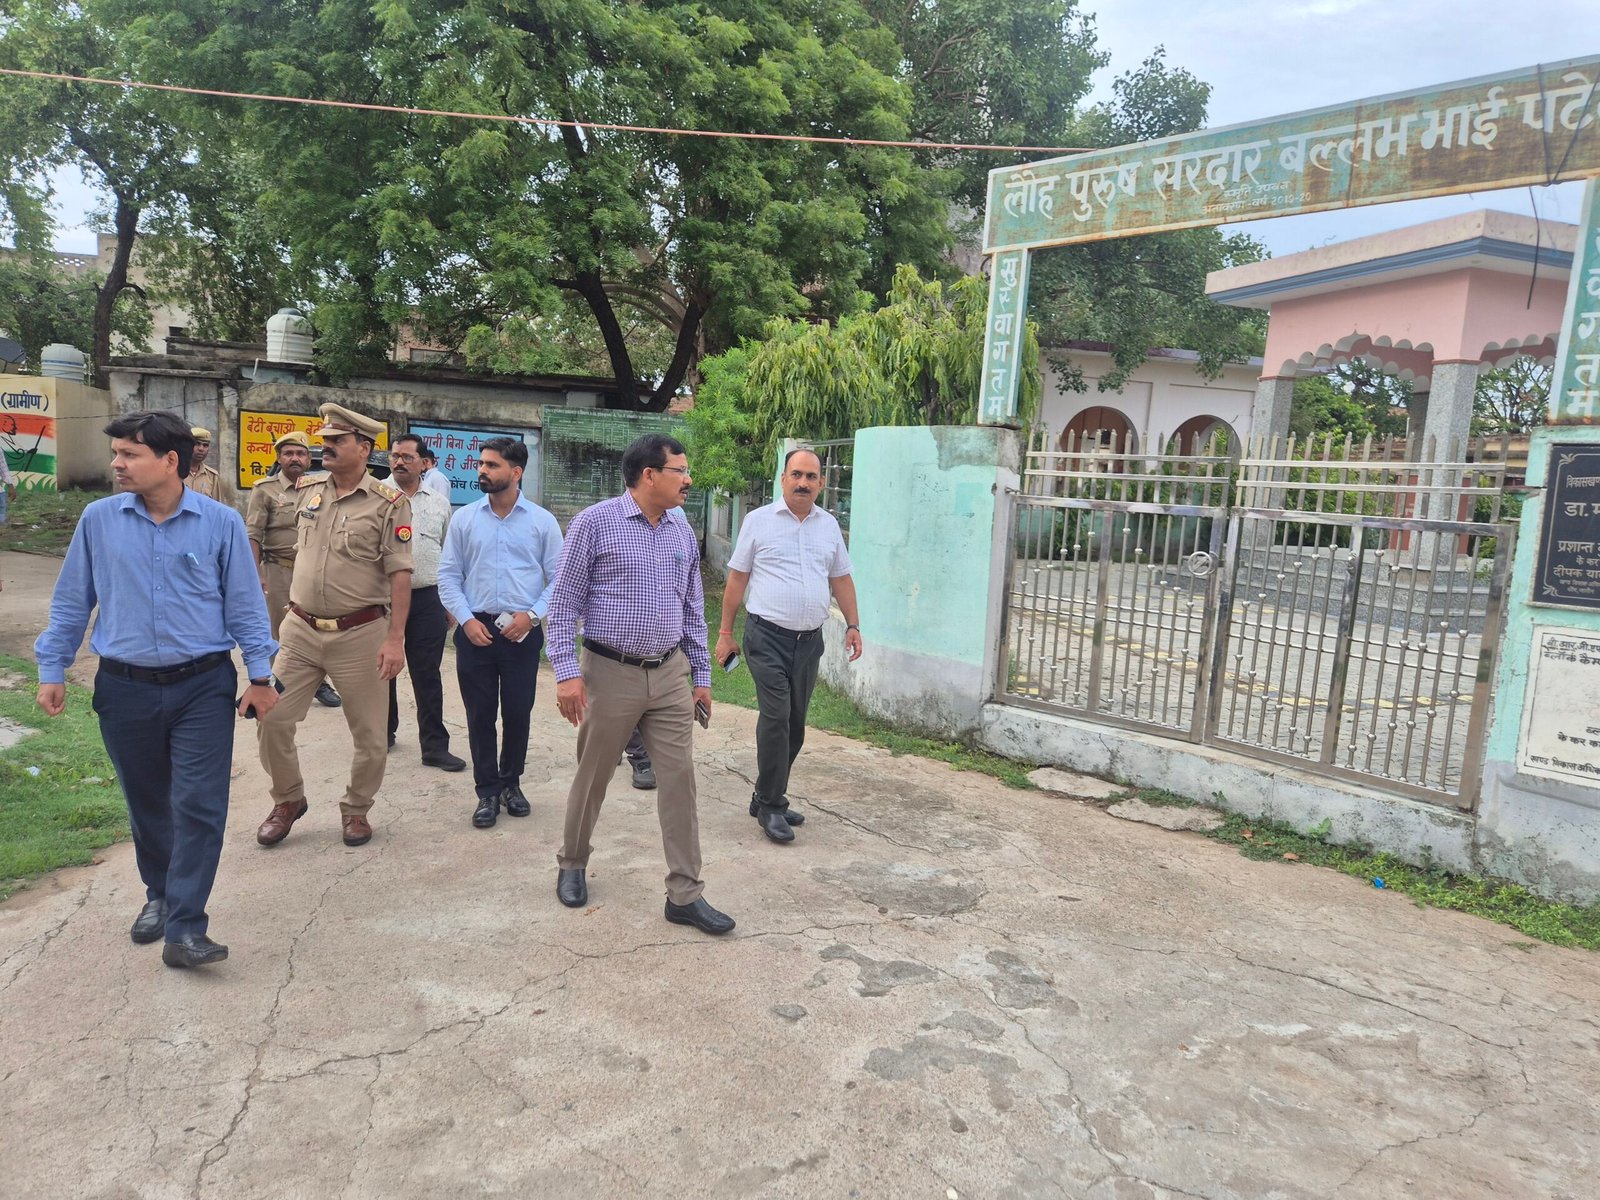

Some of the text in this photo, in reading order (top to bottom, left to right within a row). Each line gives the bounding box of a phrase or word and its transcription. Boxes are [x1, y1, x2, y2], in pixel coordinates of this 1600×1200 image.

[1152, 139, 1271, 200] सरदार
[1421, 86, 1508, 151] भाई
[1514, 71, 1600, 134] पटे
[247, 416, 266, 433] बेटी
[266, 418, 296, 435] बचाओ
[246, 442, 273, 455] कन्या
[446, 434, 464, 449] बिना
[445, 454, 456, 471] ही
[1557, 540, 1595, 554] प्रशान्त
[1553, 564, 1584, 577] दीपक
